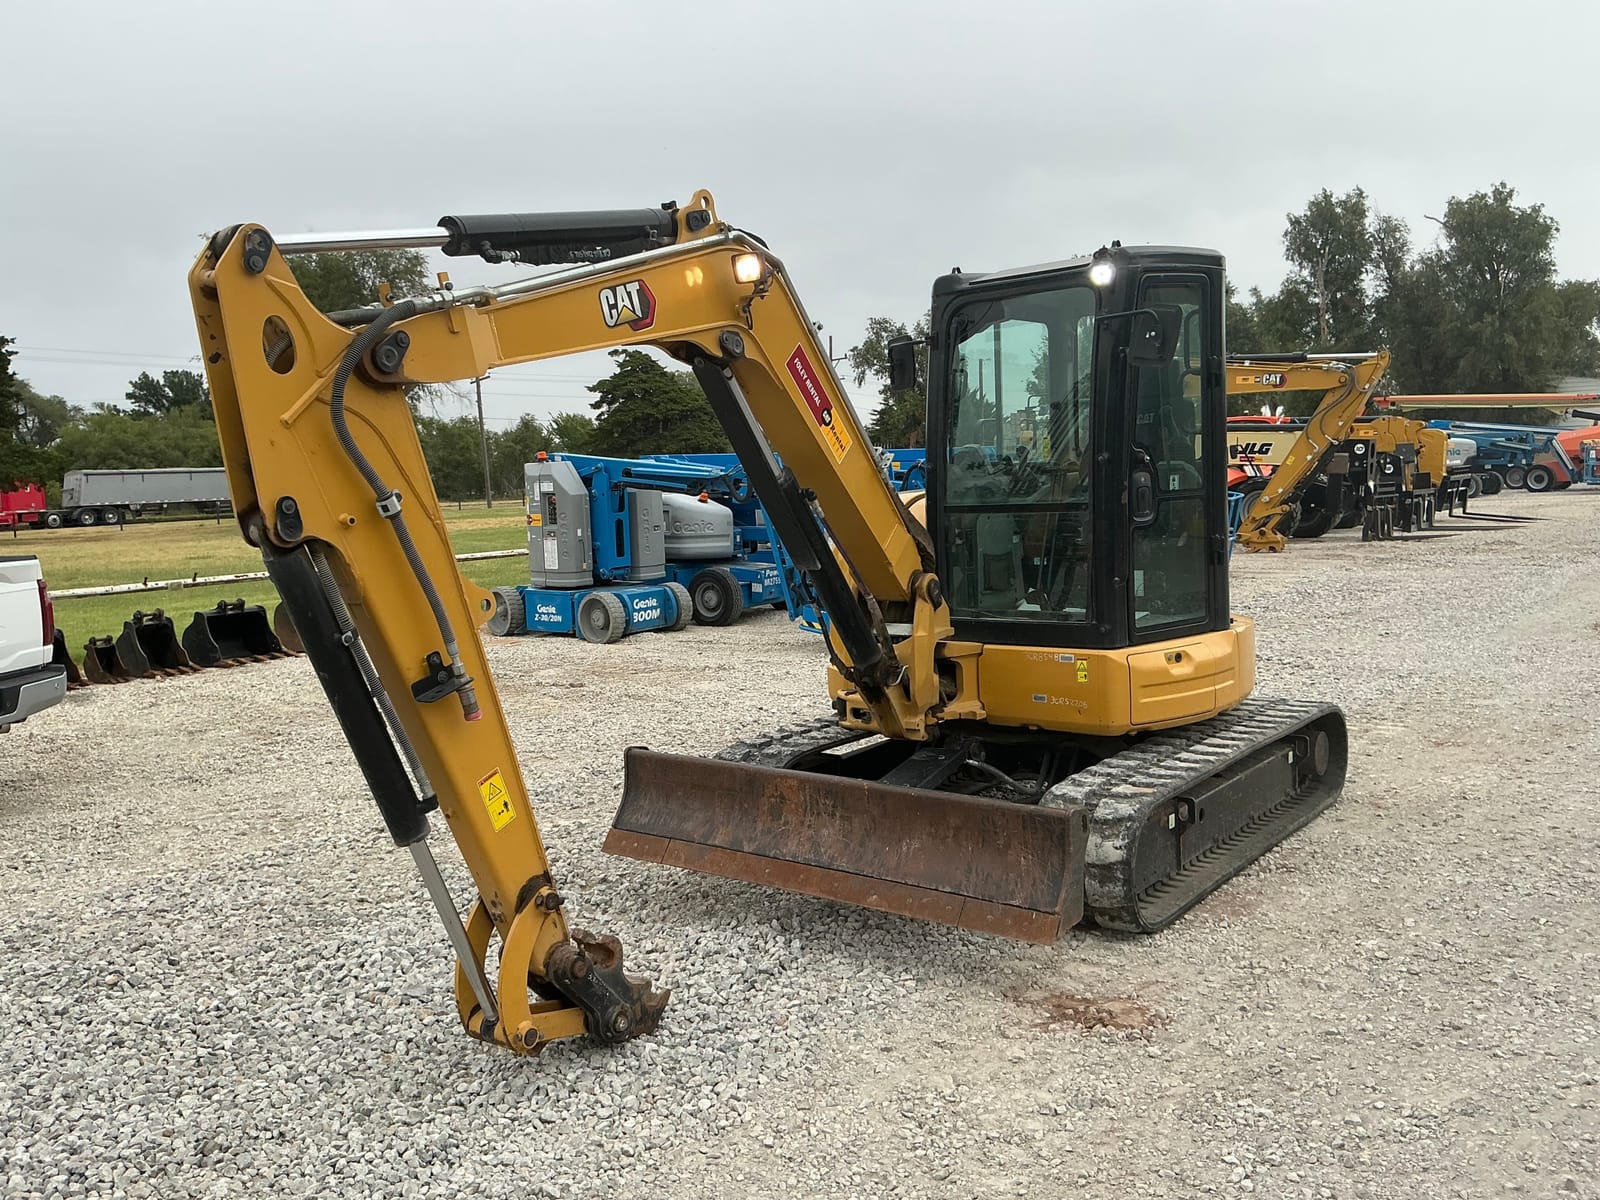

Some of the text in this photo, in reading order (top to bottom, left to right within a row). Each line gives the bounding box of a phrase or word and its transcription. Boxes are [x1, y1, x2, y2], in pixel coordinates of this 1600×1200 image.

[601, 281, 642, 326] CAT
[794, 358, 821, 407] FOLEY RENTAL
[1262, 373, 1281, 385] CAT
[830, 425, 846, 452] Rental
[1447, 448, 1461, 456] nie
[672, 520, 715, 534] Genie
[536, 604, 556, 613] Genie
[633, 597, 657, 609] Genie
